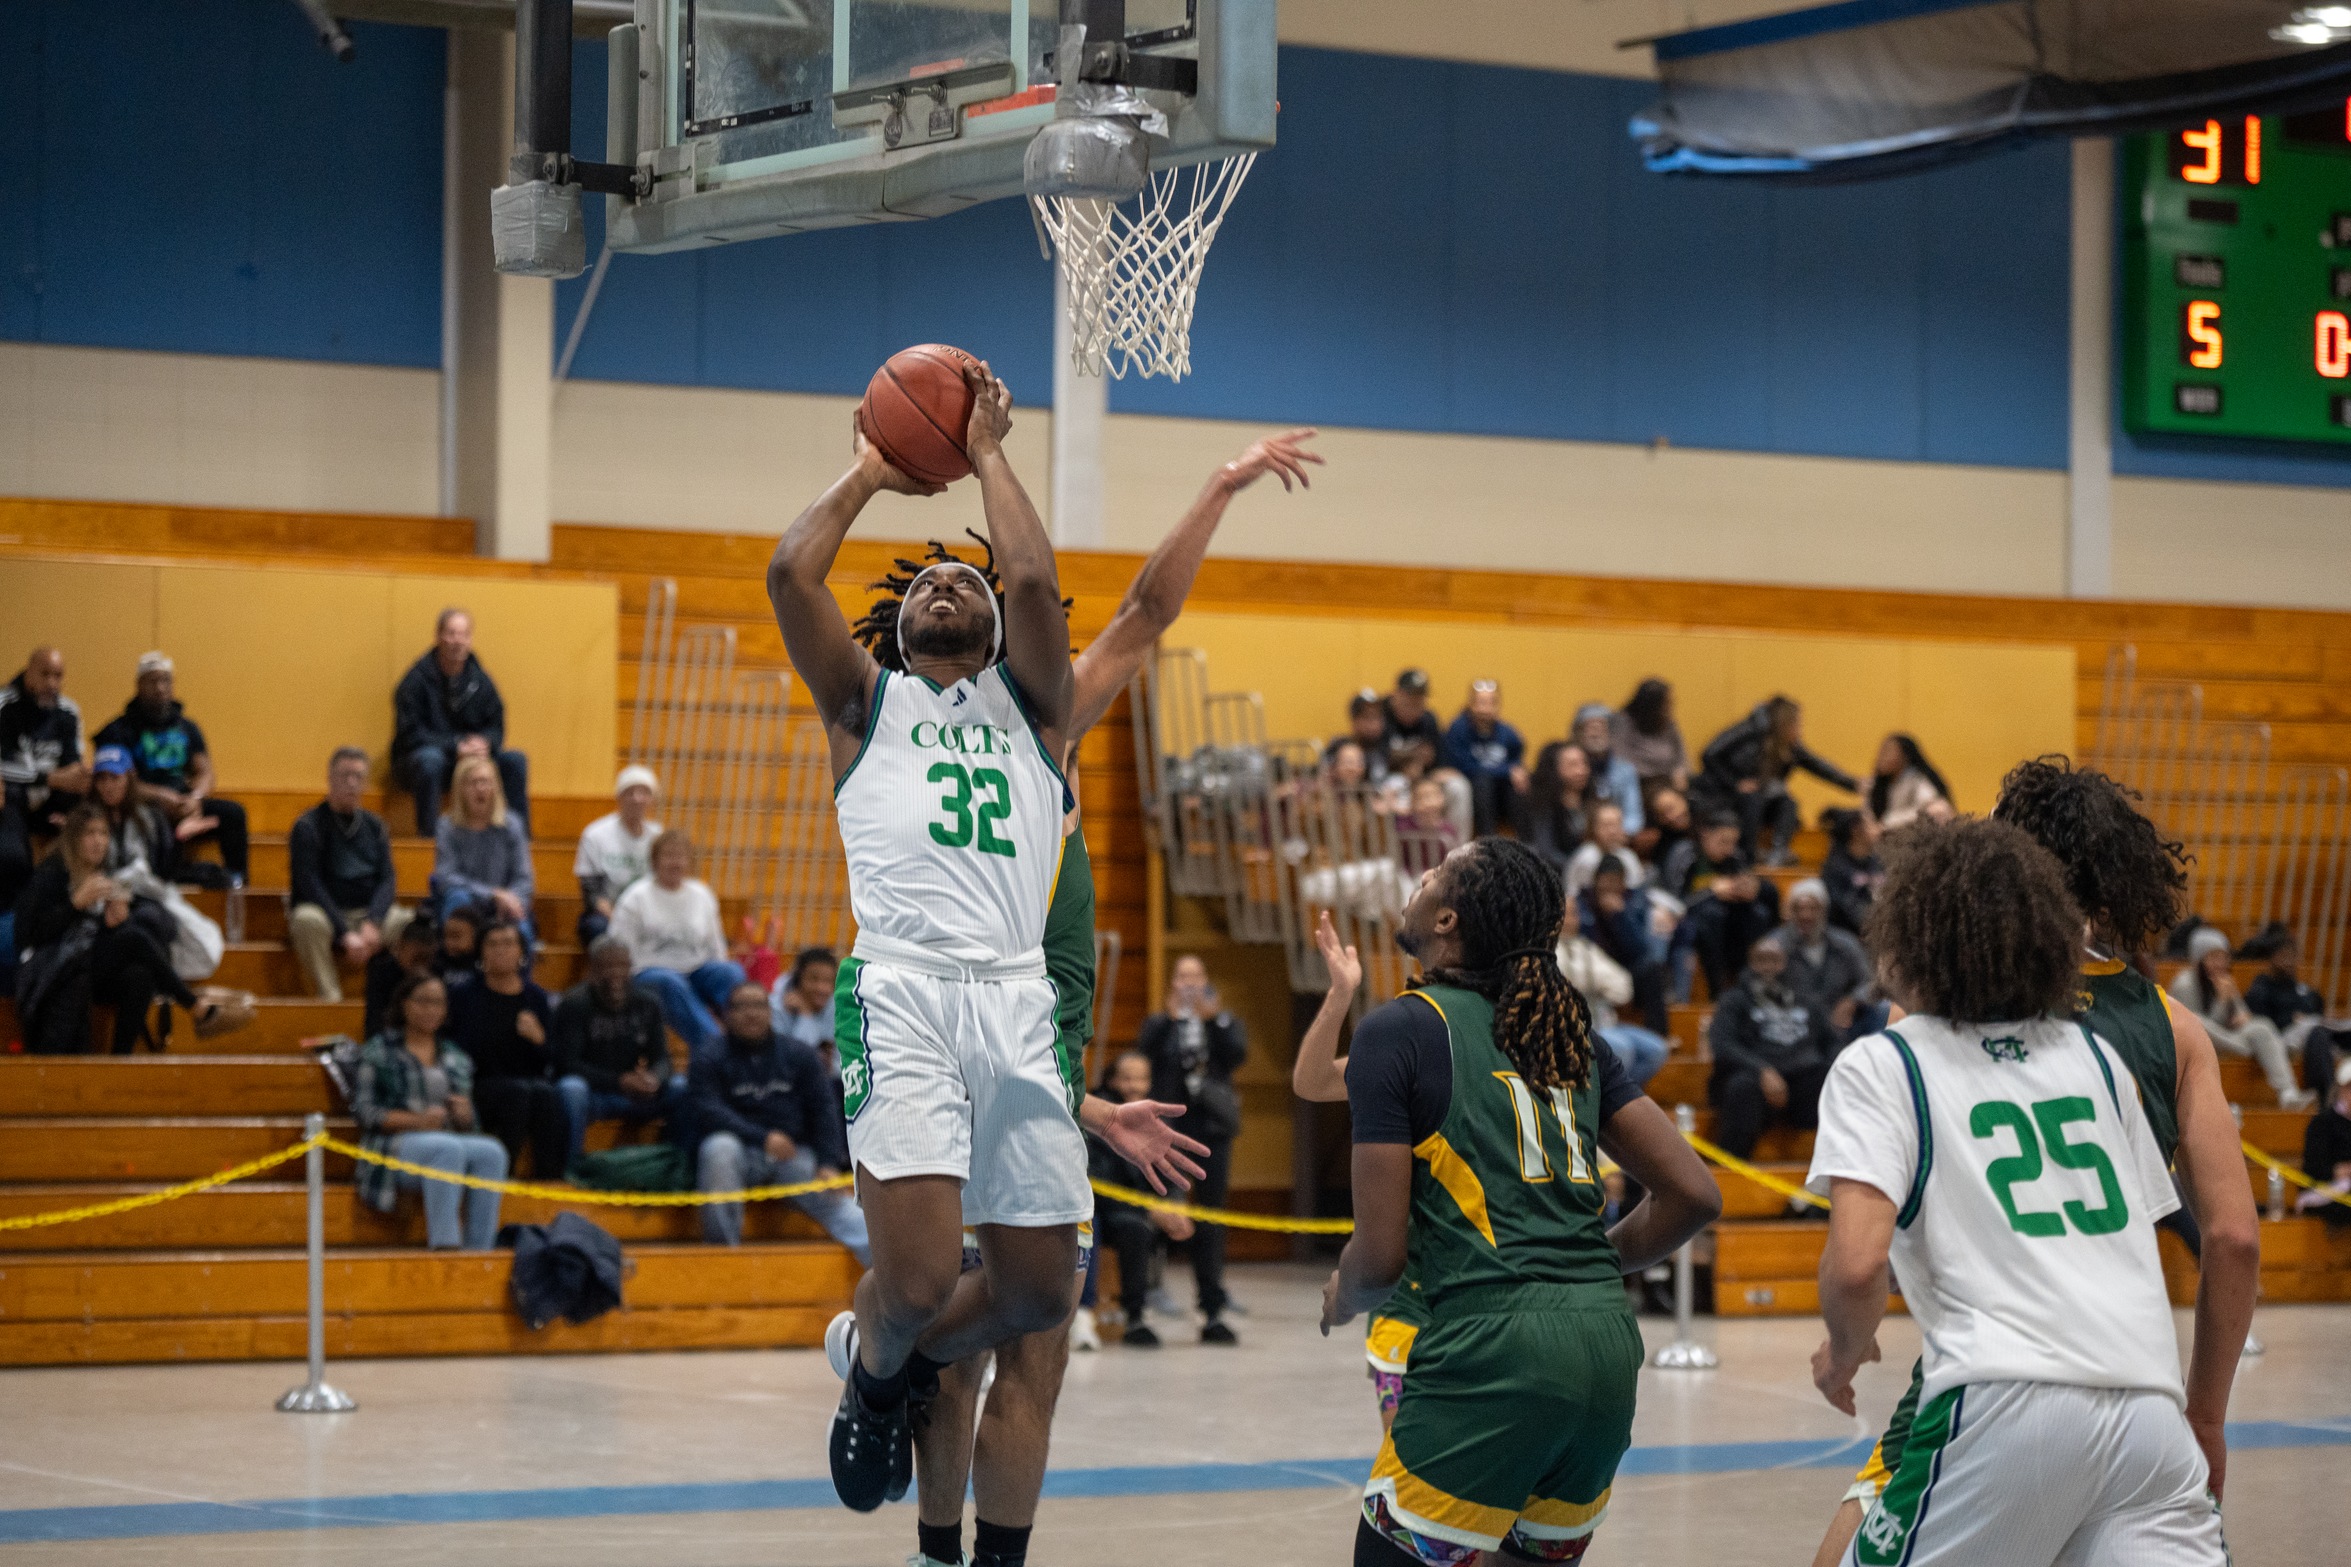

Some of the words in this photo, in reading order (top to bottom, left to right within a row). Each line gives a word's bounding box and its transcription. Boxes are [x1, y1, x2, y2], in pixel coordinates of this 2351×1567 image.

[2187, 300, 2223, 369] 5
[2314, 310, 2351, 378] 0
[911, 721, 1011, 755] COLTS
[927, 762, 1016, 858] 32
[1492, 1070, 1595, 1184] 11
[1969, 1096, 2129, 1237] 25
